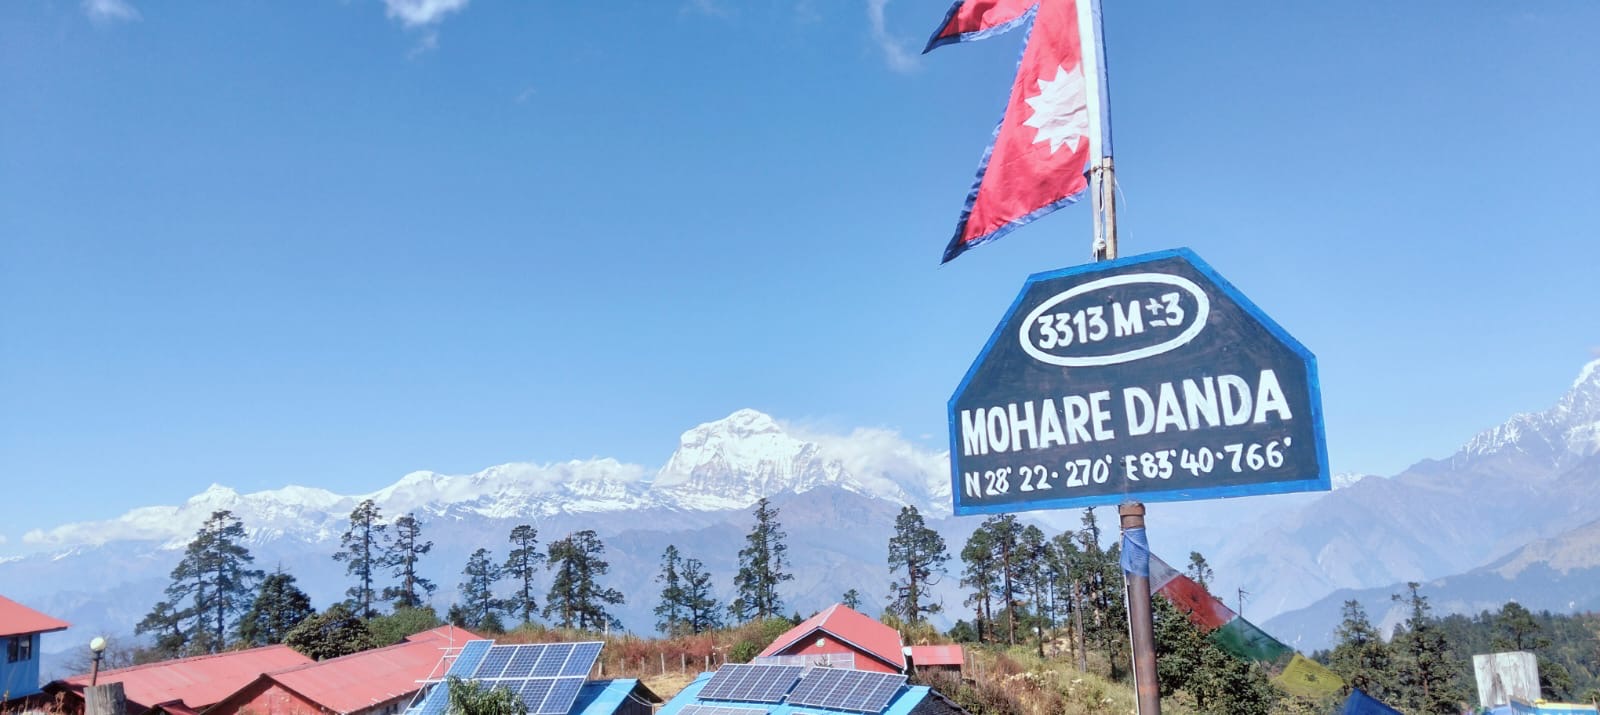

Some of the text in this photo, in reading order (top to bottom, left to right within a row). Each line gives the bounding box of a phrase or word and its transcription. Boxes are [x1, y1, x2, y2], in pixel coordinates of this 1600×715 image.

[1038, 306, 1108, 350] 3313
[1113, 300, 1144, 337] M
[961, 369, 1293, 457] MOHARE DANDA
